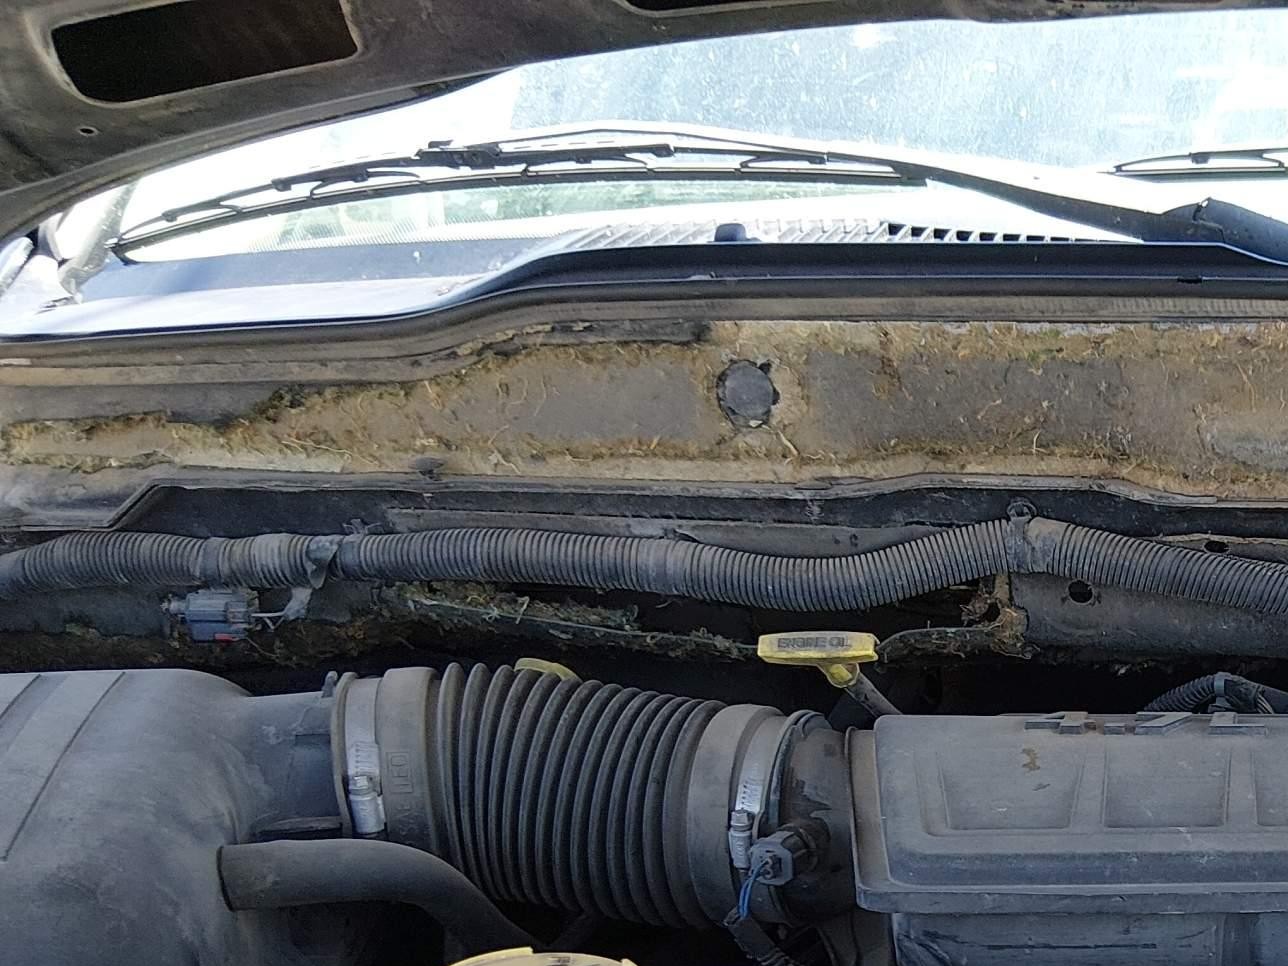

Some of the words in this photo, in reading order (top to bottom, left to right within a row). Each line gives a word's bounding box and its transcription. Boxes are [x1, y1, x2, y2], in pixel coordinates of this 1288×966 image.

[777, 636, 827, 649] ENGINE
[828, 635, 852, 648] OIL
[1024, 711, 1268, 736] 4.7L
